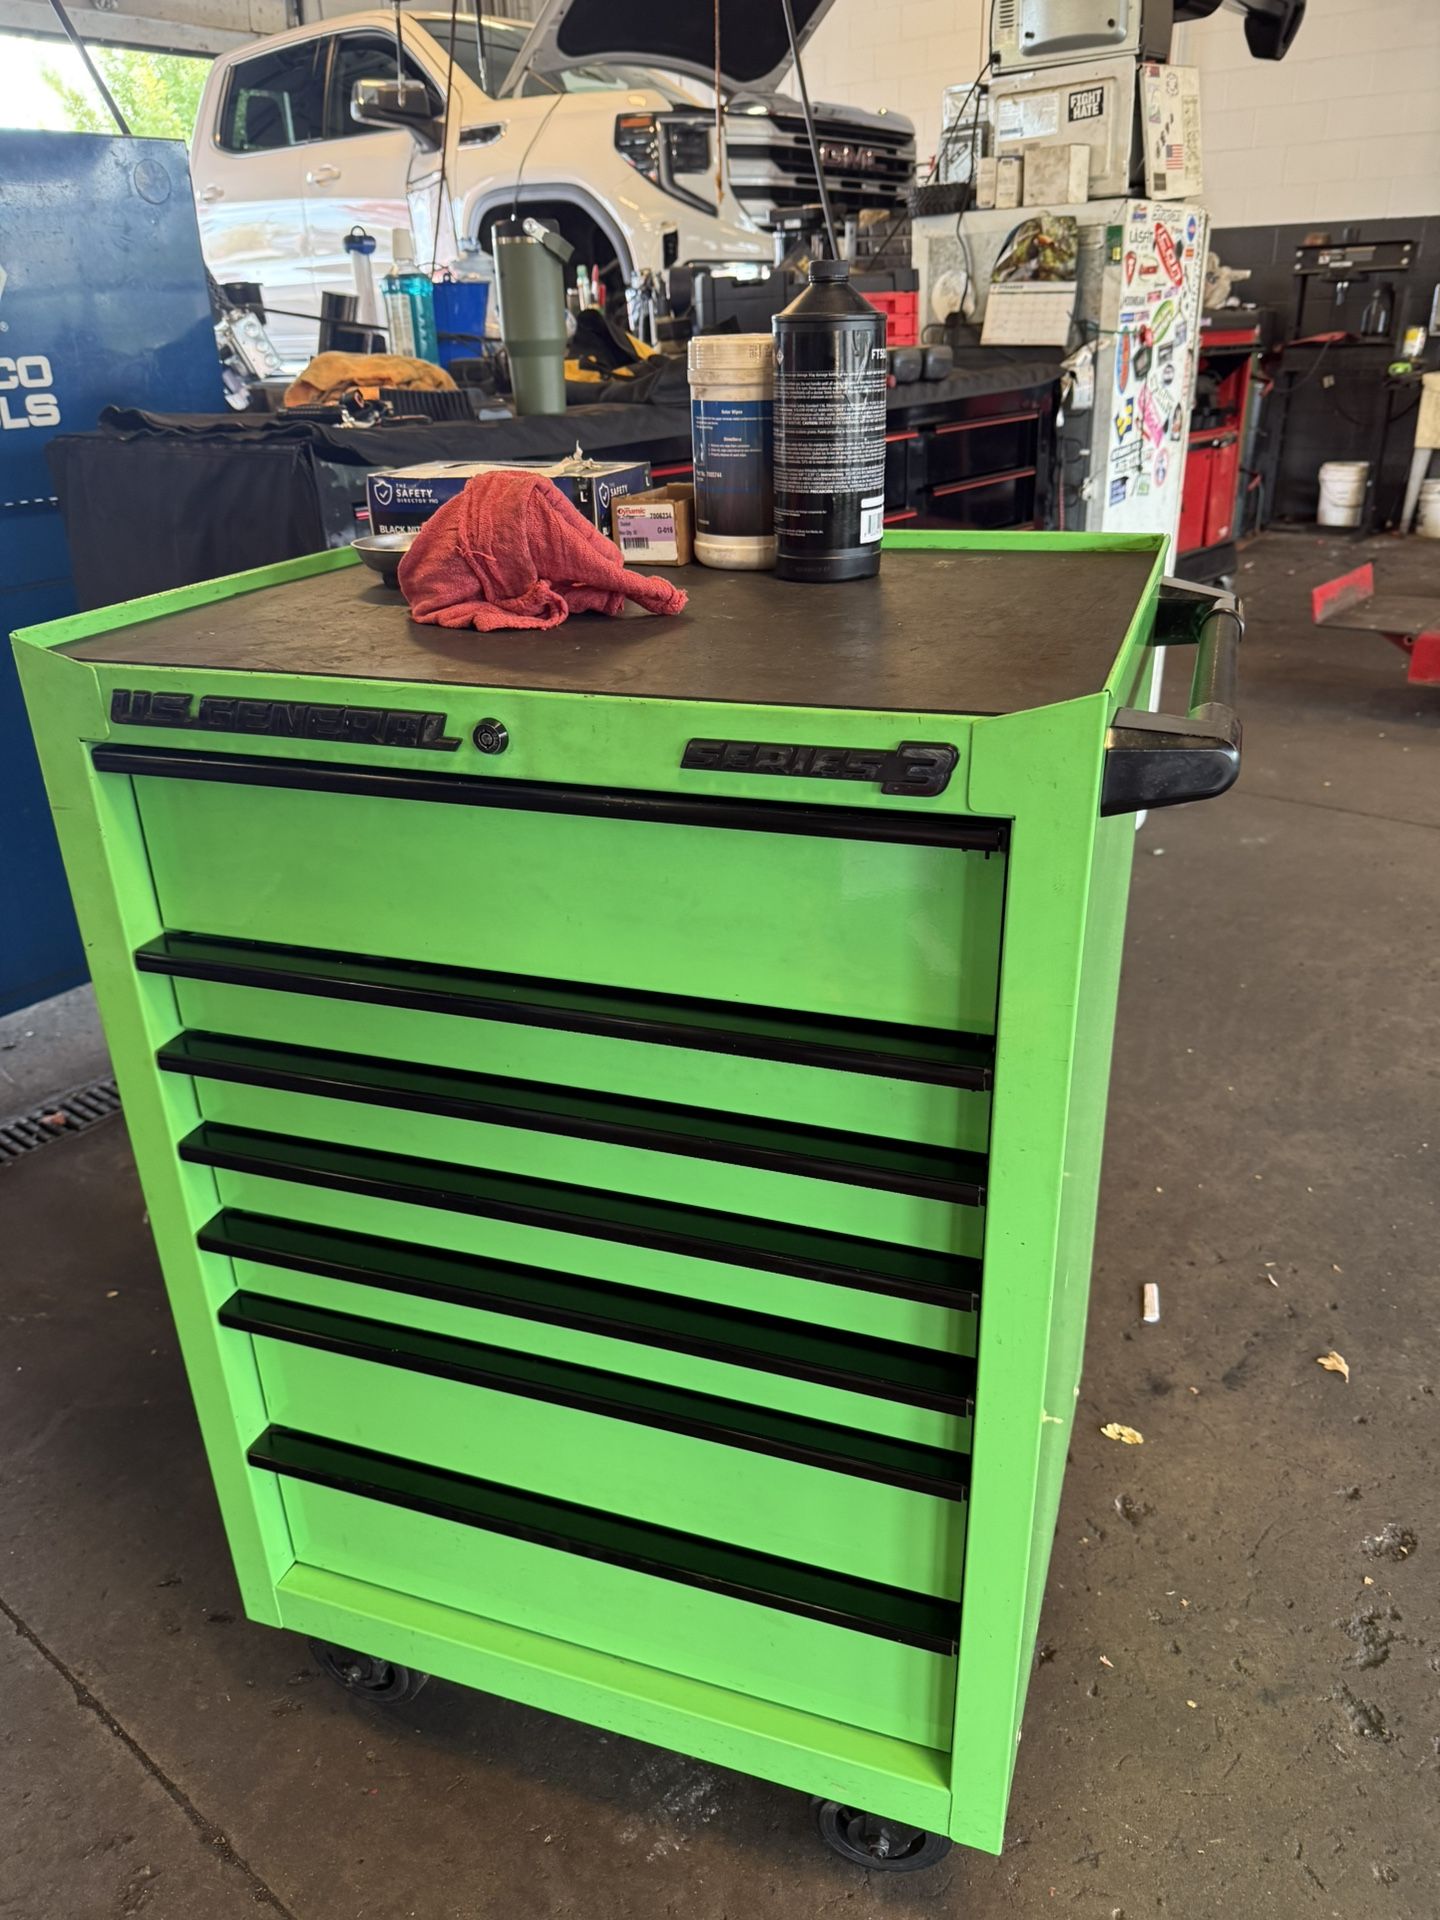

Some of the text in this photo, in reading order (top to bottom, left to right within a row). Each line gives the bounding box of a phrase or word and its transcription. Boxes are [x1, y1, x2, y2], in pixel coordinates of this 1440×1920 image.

[1070, 89, 1102, 108] FIGHT
[1073, 102, 1099, 120] HATE
[819, 143, 887, 171] GMC
[395, 488, 433, 498] SAFETY
[580, 491, 588, 502] L
[610, 484, 628, 497] SAFETY
[379, 524, 406, 533] BLACK
[680, 737, 961, 798] SERIES 3
